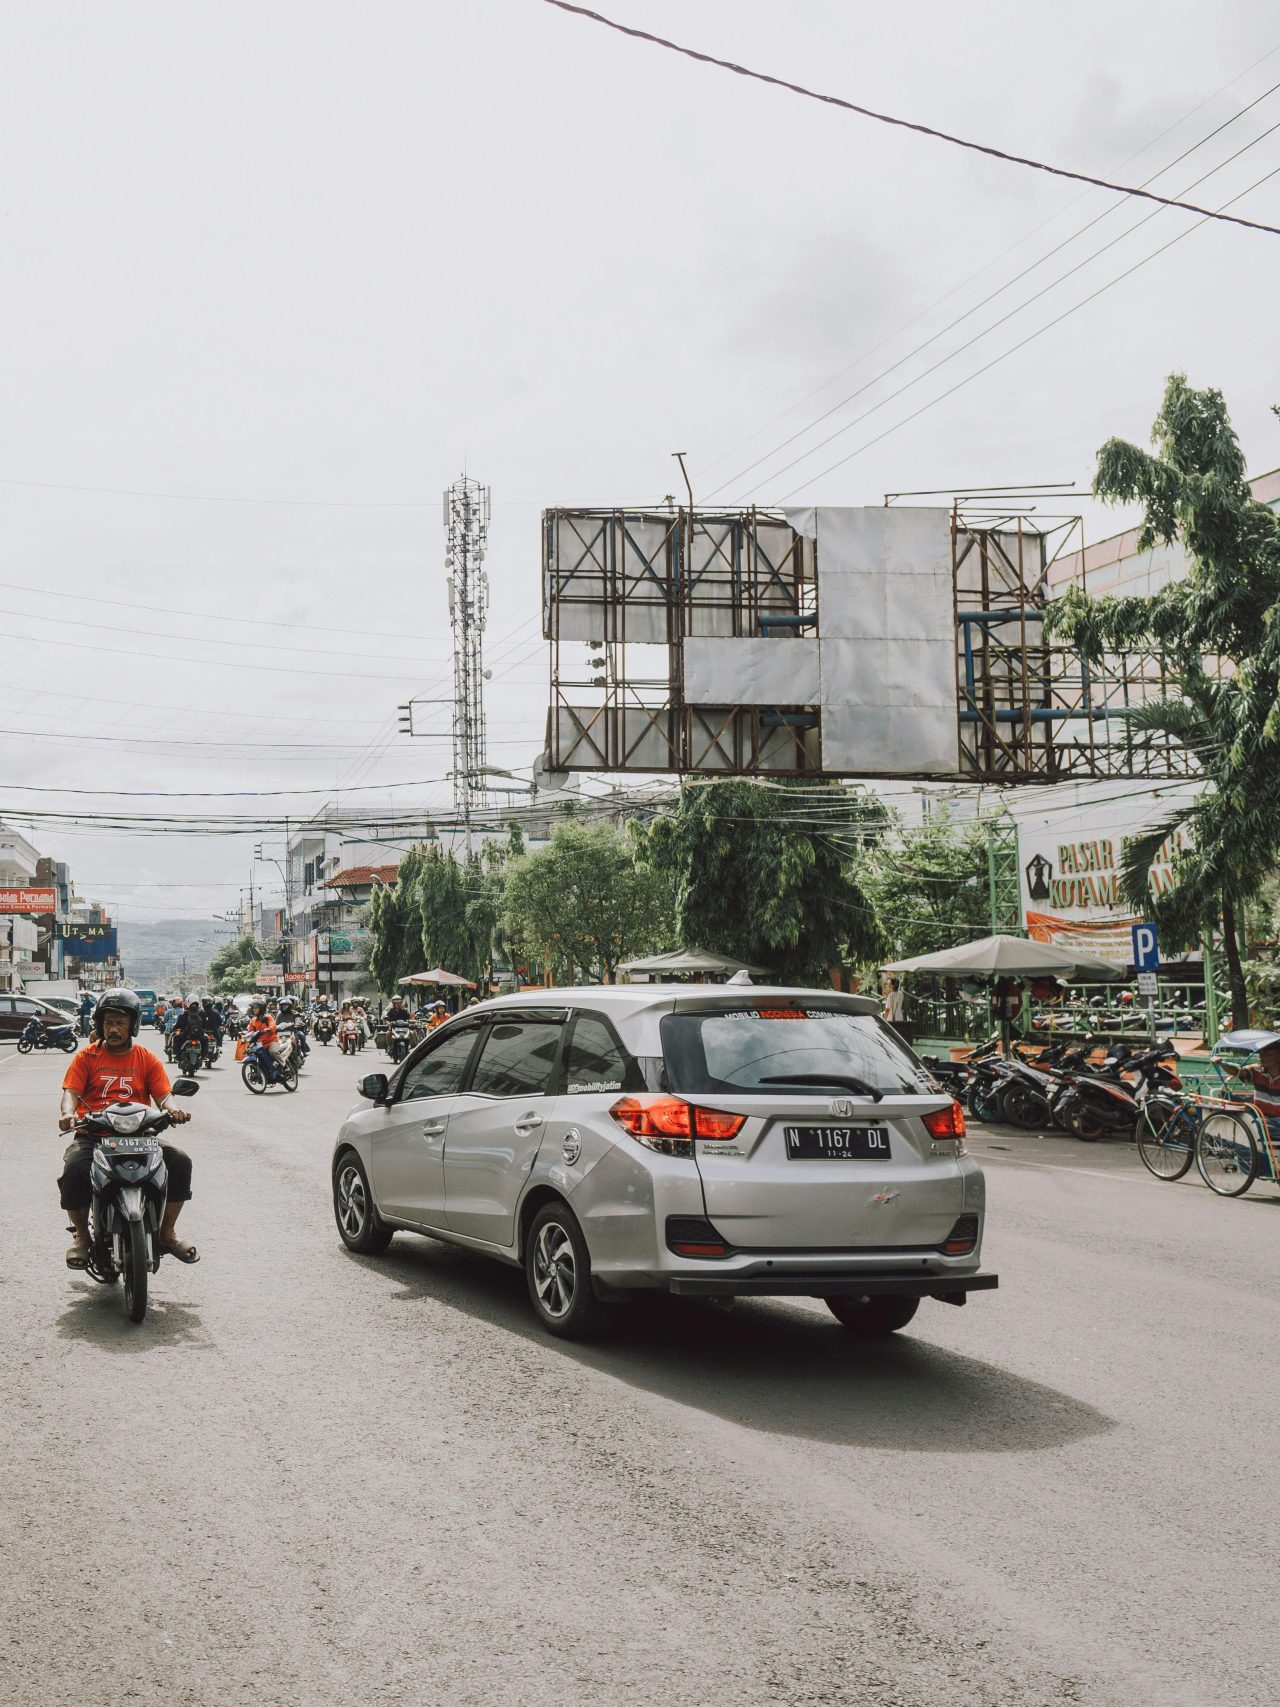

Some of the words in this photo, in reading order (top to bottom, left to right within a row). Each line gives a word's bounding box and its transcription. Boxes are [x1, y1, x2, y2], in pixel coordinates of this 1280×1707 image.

[1057, 838, 1114, 875] PASAR
[1136, 928, 1154, 967] P
[723, 1010, 761, 1021] MOBILIO
[760, 1009, 805, 1020] INDONESIA
[100, 1075, 133, 1099] 75
[789, 1128, 800, 1147] N
[816, 1129, 851, 1148] 1167
[867, 1129, 887, 1149] DL
[827, 1150, 853, 1158] 11-24
